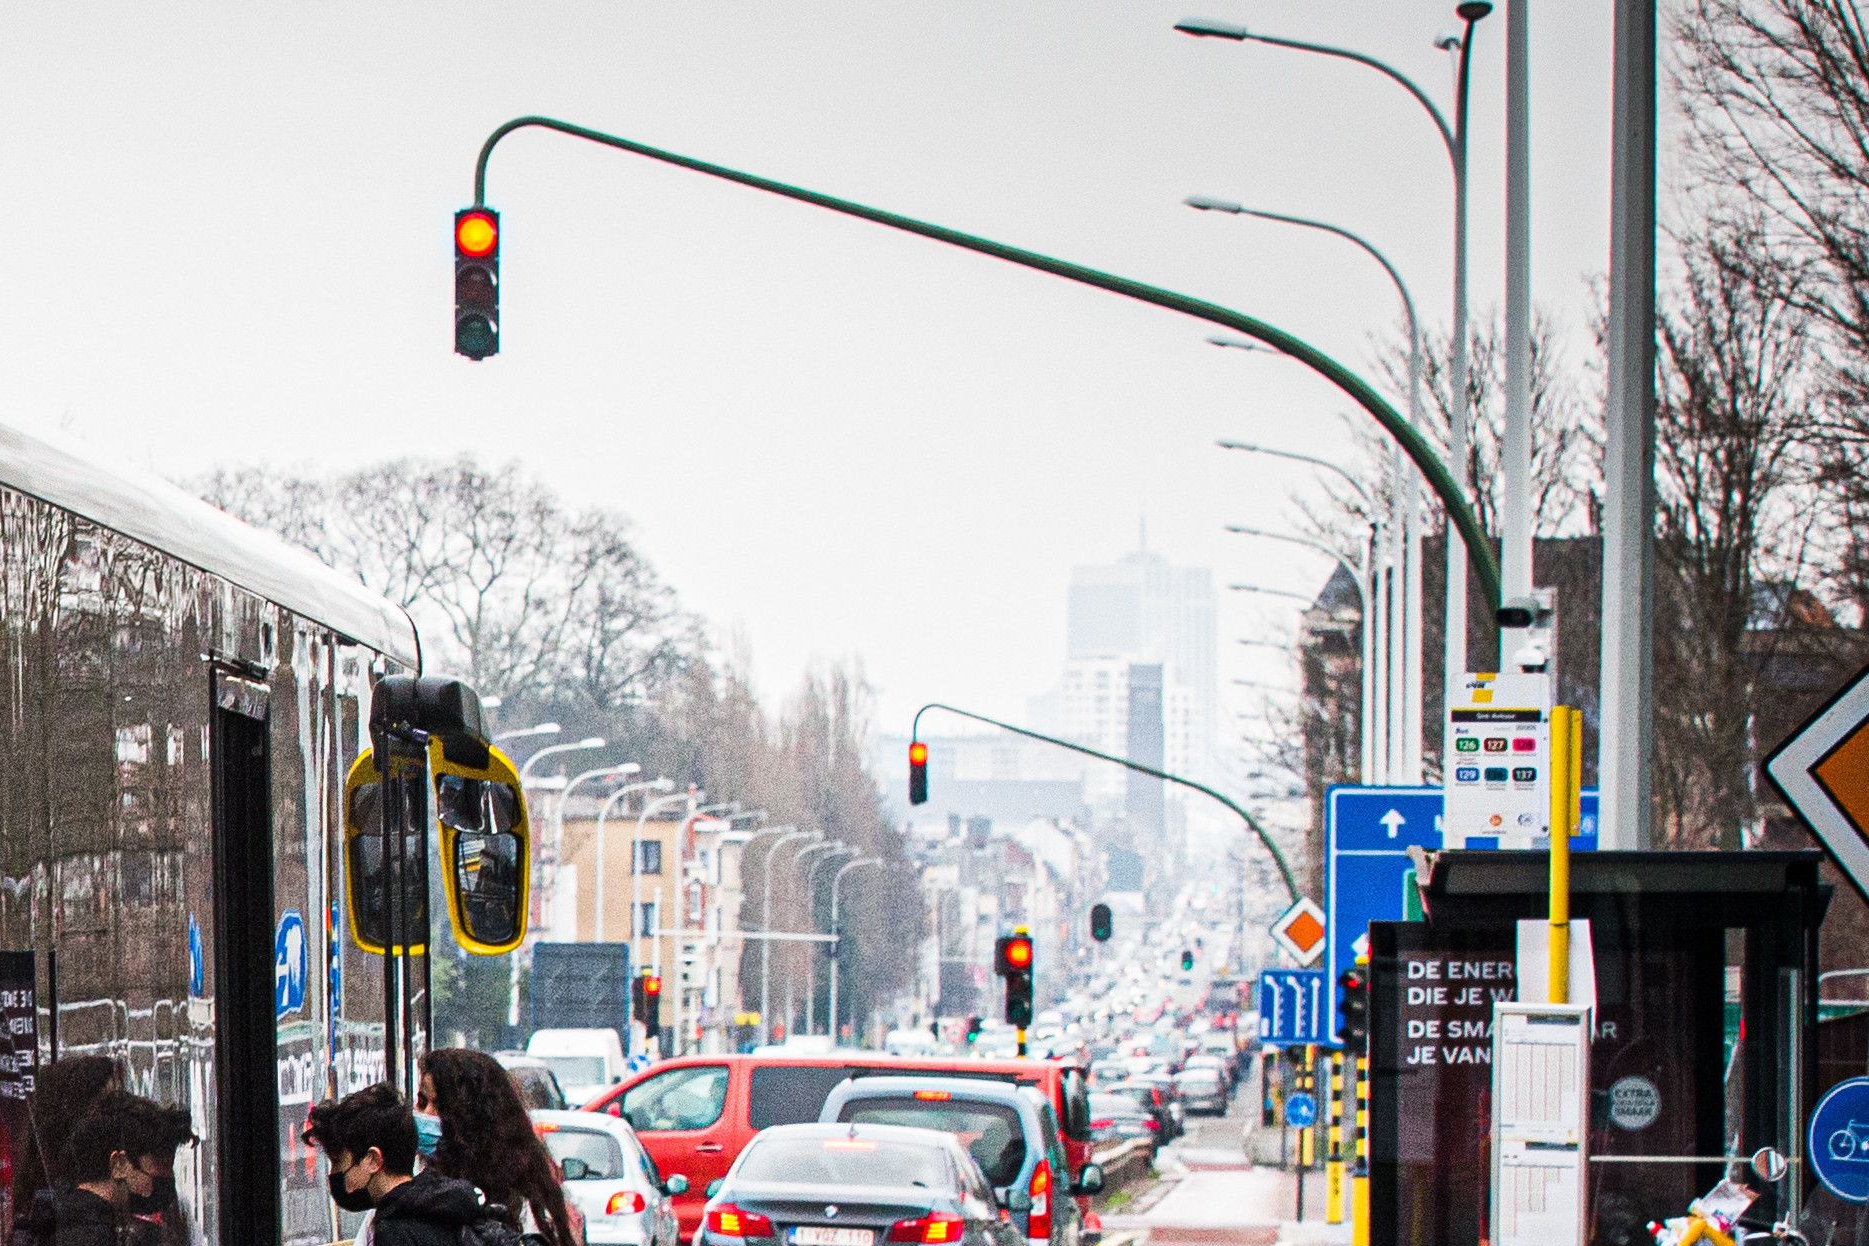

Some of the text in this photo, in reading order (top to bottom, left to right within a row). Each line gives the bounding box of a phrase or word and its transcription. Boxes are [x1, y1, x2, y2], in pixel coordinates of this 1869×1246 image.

[1407, 960, 1513, 980] DE ENER
[1407, 986, 1449, 1006] DIE
[1453, 986, 1484, 1005] JE
[1407, 1019, 1442, 1039] DE
[1406, 1045, 1492, 1065] JE VAN
